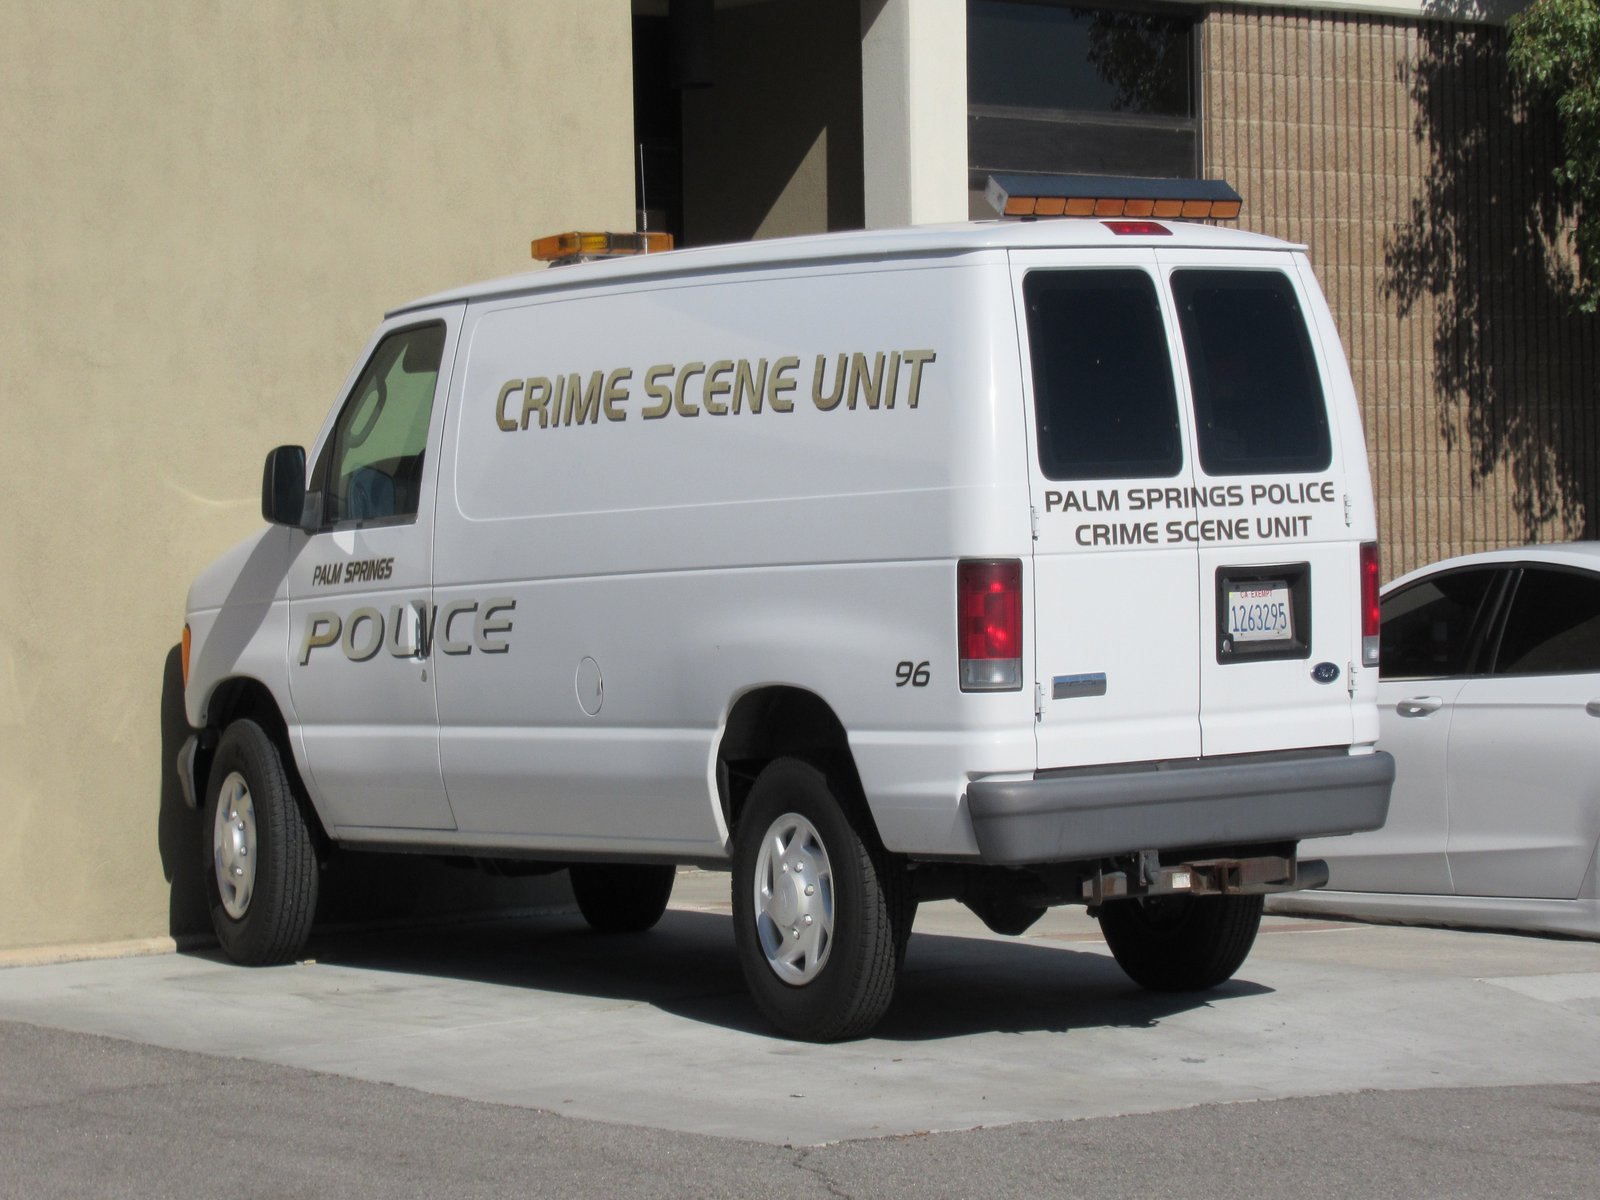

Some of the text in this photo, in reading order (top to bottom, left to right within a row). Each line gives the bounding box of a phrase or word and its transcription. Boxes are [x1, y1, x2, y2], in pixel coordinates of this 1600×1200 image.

[495, 349, 936, 431] CRIME SCENE UNIT
[1045, 481, 1335, 513] PALM SPRINGS POLICE
[1075, 515, 1313, 546] CRIME SCENE UNIT
[312, 557, 394, 585] PALM SPRINGS
[1232, 603, 1286, 632] 1263295
[895, 660, 931, 687] 96
